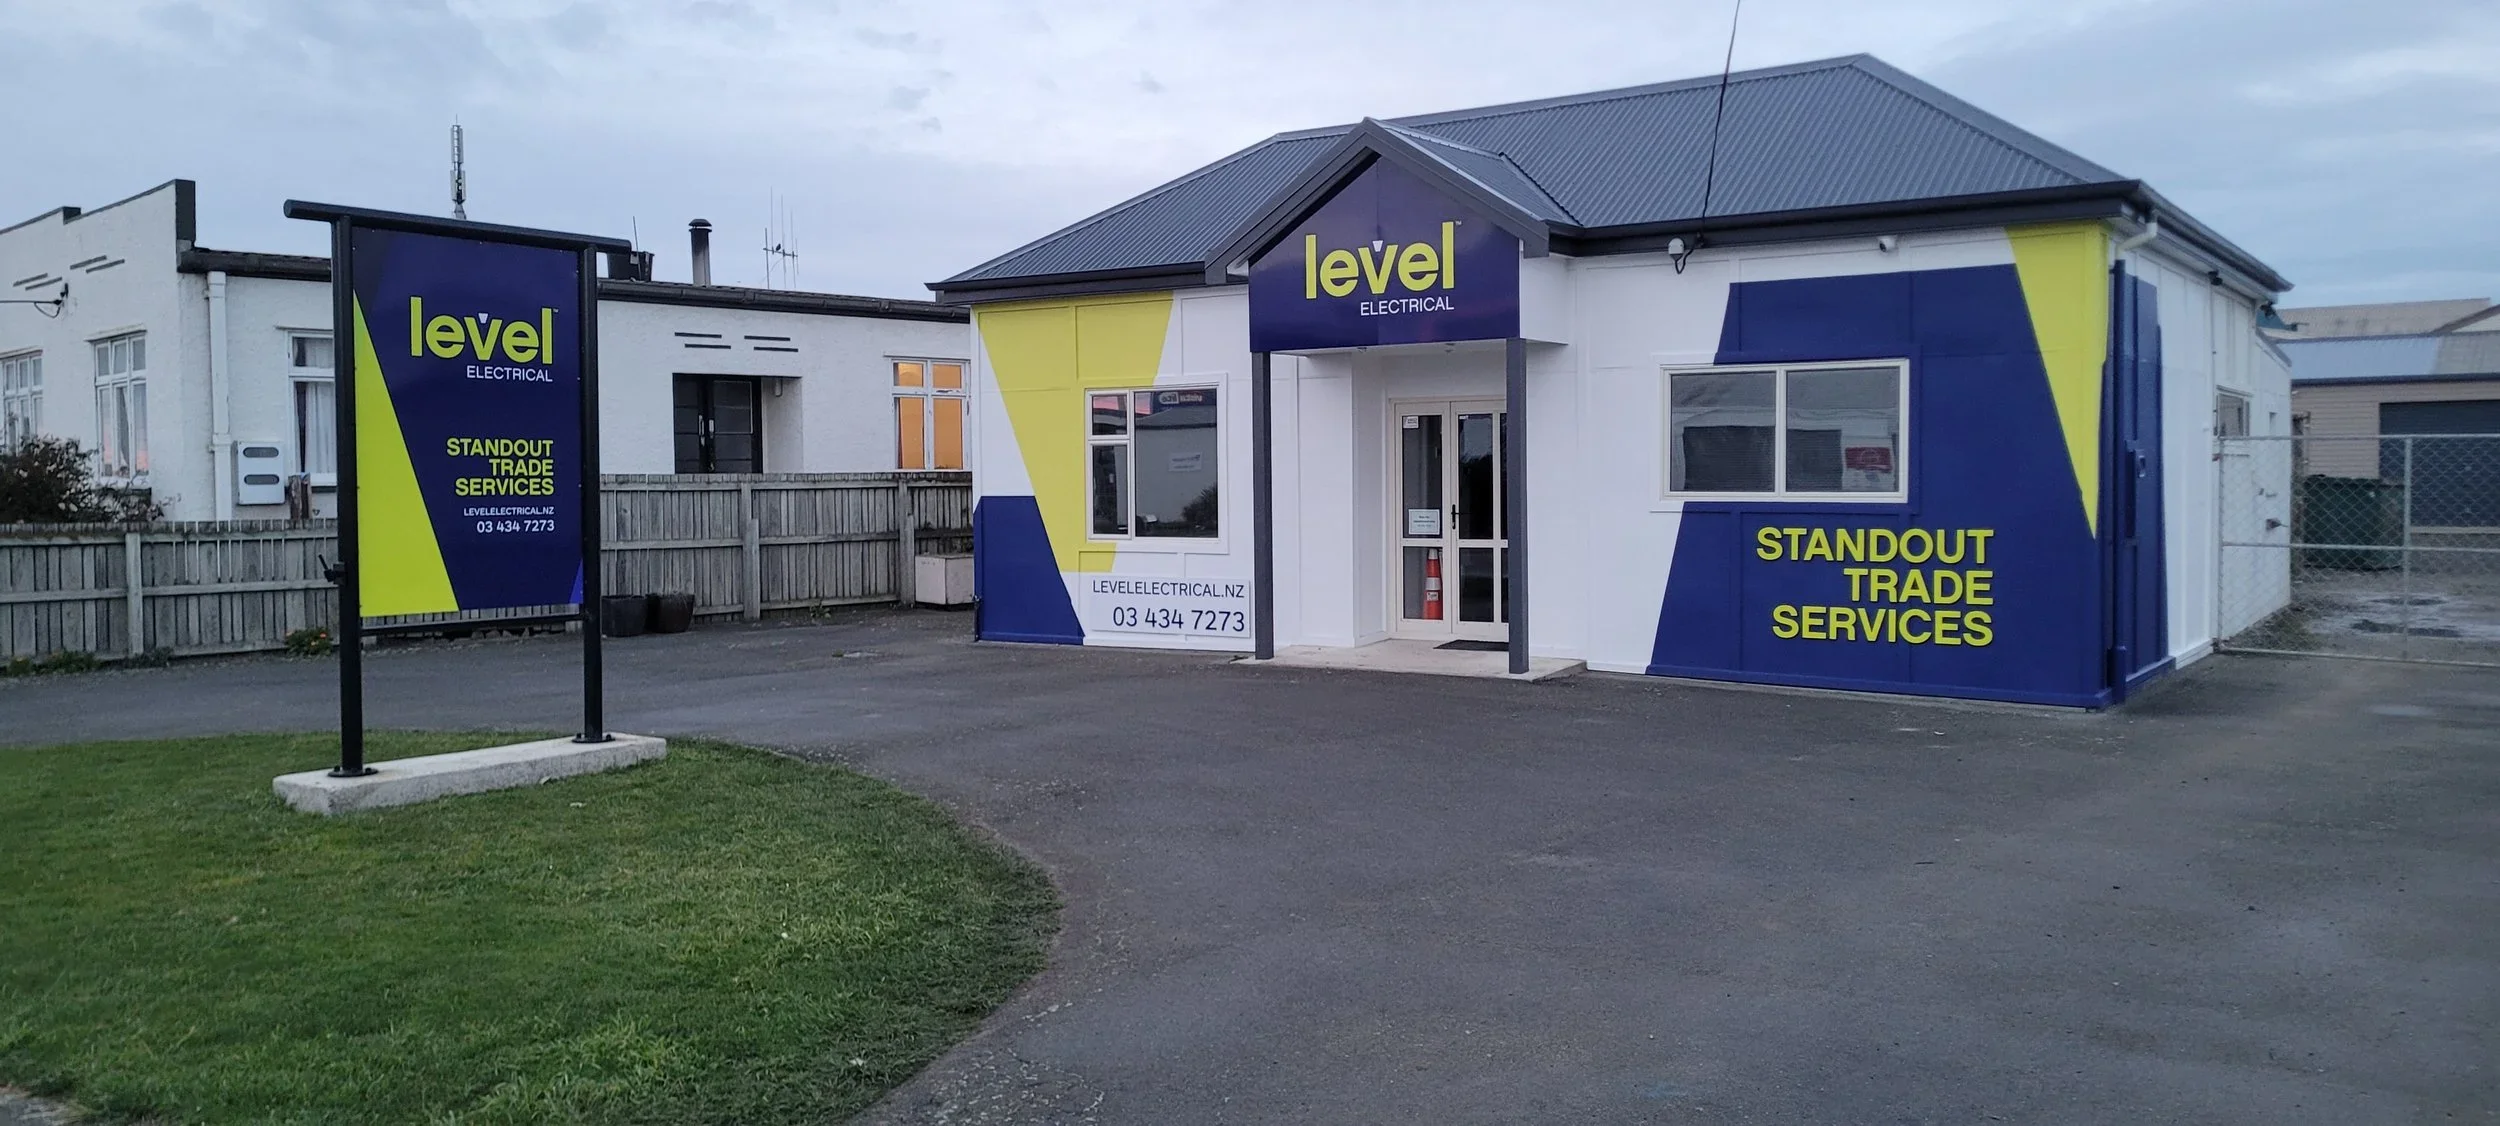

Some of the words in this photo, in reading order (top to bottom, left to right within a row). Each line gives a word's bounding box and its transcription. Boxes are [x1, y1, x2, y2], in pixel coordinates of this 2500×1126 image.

[1305, 221, 1455, 299] level
[1360, 296, 1455, 316] ELECTRICAL
[410, 296, 553, 364] level
[466, 365, 553, 382] ELECTRICAL
[446, 437, 554, 457] STANDOUT
[488, 458, 554, 476] TRADE
[455, 477, 555, 496] SERVICES
[463, 506, 555, 516] LEVELELECTRICAL.NZ
[476, 520, 493, 533] 03
[496, 520, 520, 532] 434
[523, 519, 555, 532] 7273
[1756, 526, 1994, 564] STANDOUT
[1092, 580, 1245, 598] LEVELELECTRICAL.NZ
[1843, 568, 1994, 605] TRADE
[1112, 606, 1138, 627] 03
[1144, 607, 1184, 629] 434
[1191, 609, 1245, 632] 7273
[1772, 604, 1994, 646] SERVICES
